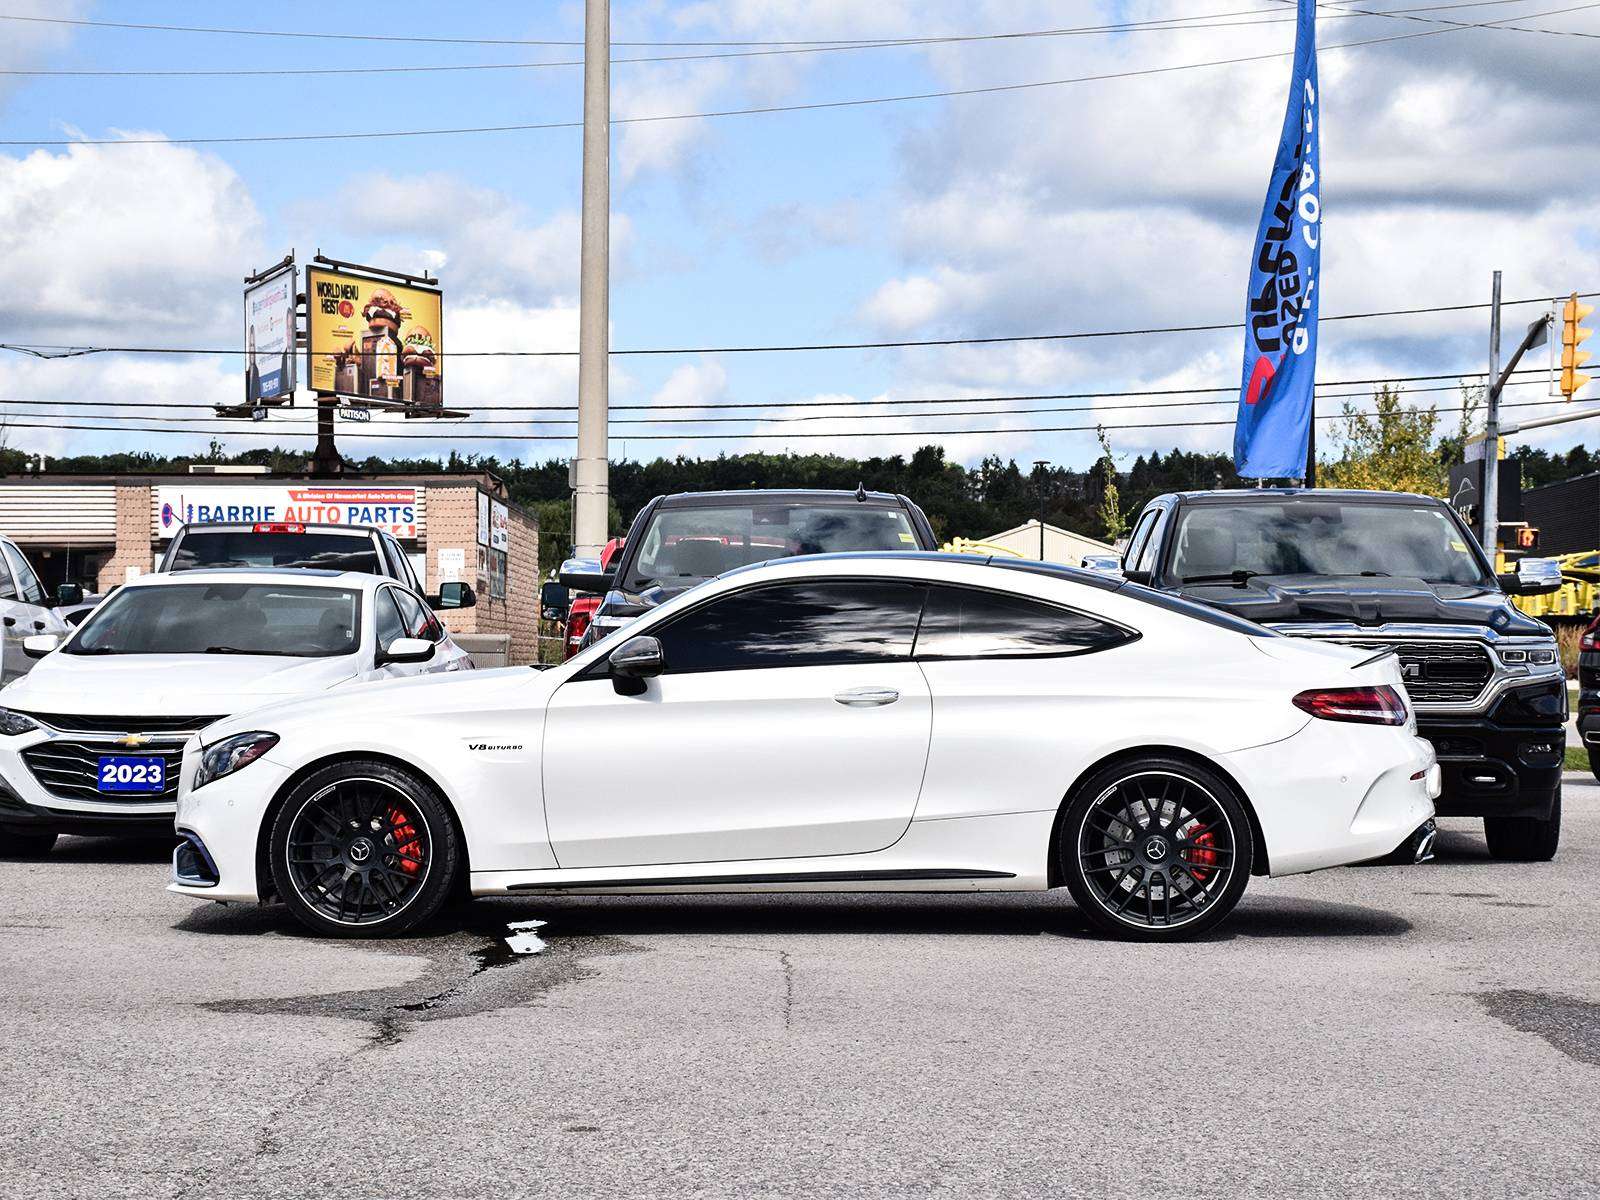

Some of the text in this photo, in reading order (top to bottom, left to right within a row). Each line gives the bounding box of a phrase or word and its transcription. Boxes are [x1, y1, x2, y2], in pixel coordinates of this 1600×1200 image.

[316, 281, 359, 301] WORLD MENU
[197, 505, 415, 524] BARRIE AUTO PARTS
[102, 764, 162, 784] 2023
